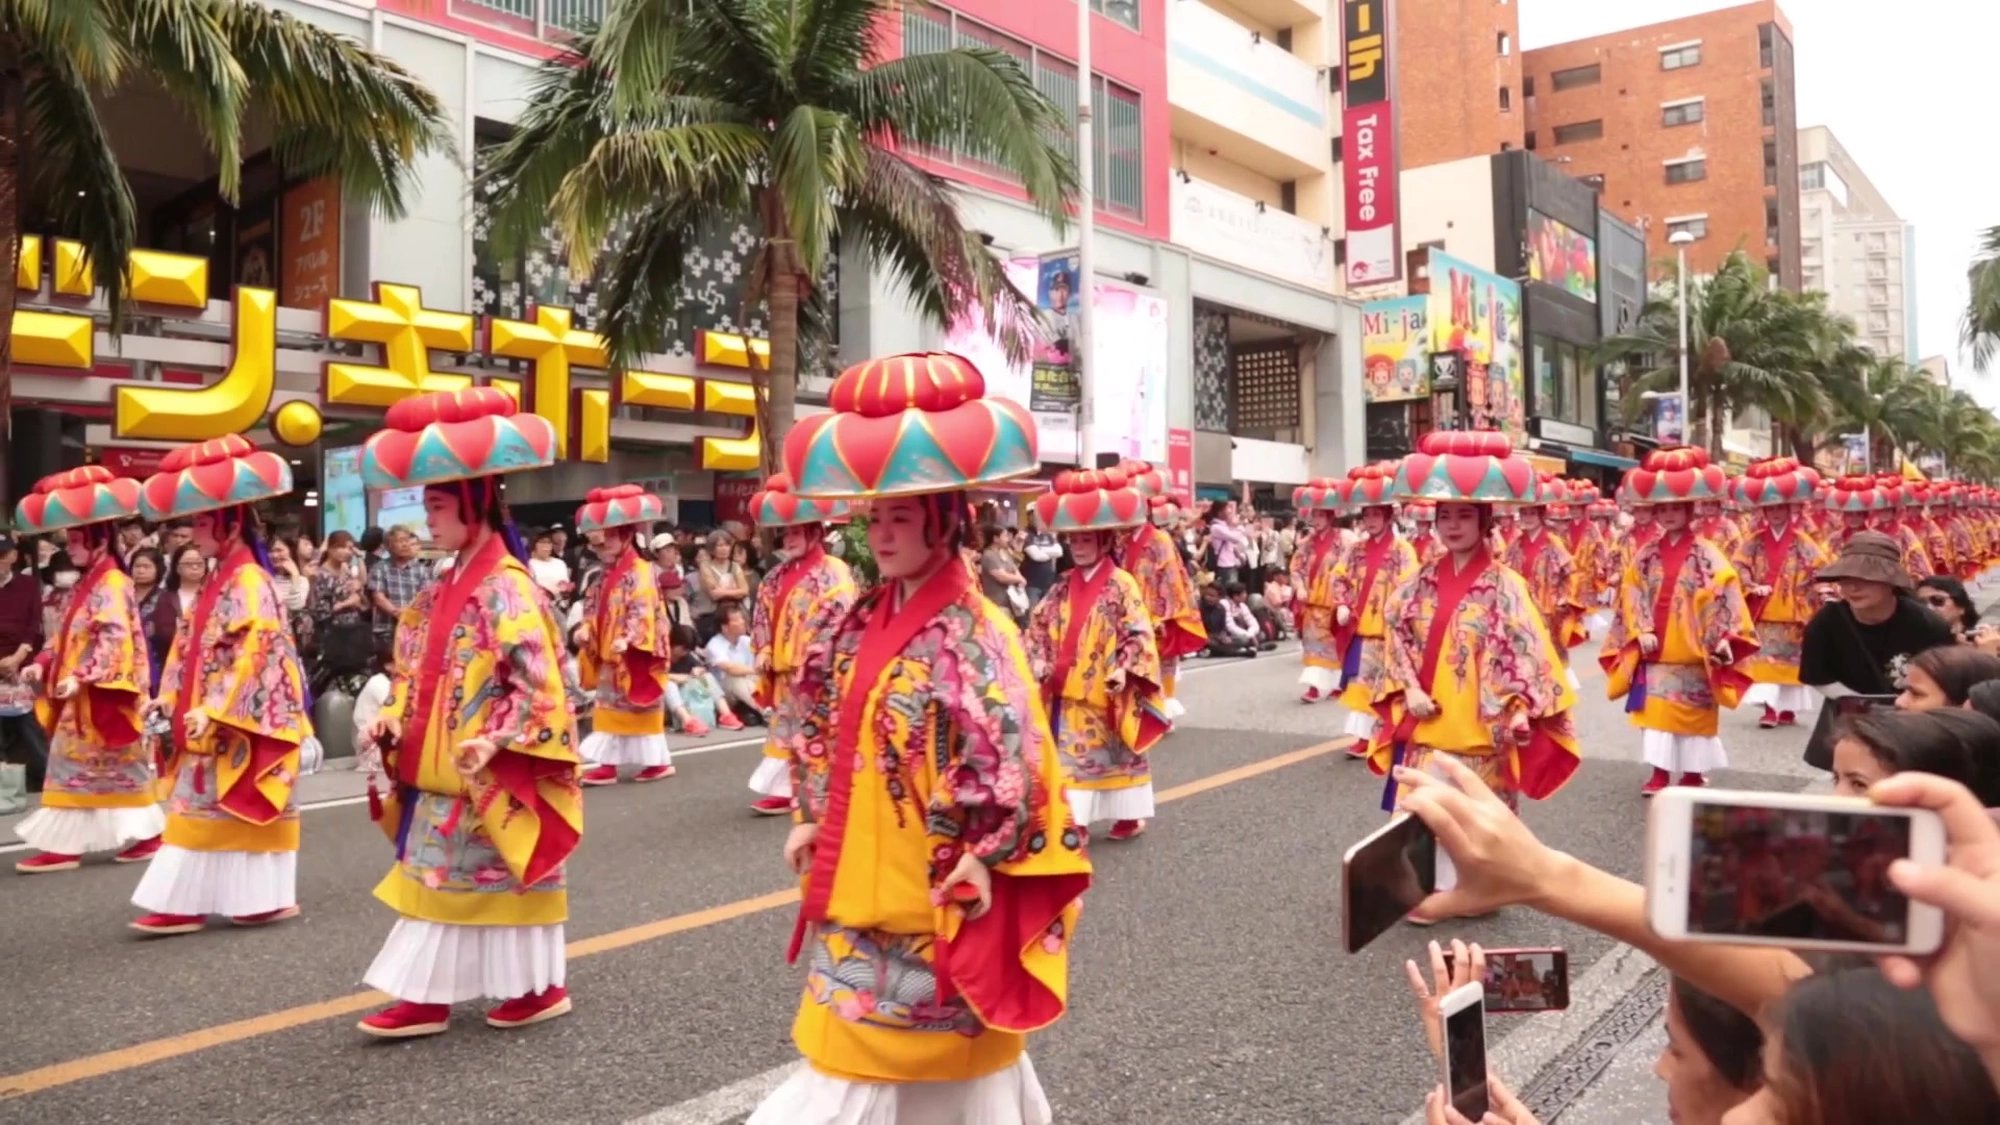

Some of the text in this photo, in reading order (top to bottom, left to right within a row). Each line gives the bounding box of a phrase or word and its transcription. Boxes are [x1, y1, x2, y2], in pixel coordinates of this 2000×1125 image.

[1357, 113, 1378, 222] Tax Free
[300, 200, 325, 242] 2F
[1363, 308, 1421, 342] Mi-ja
